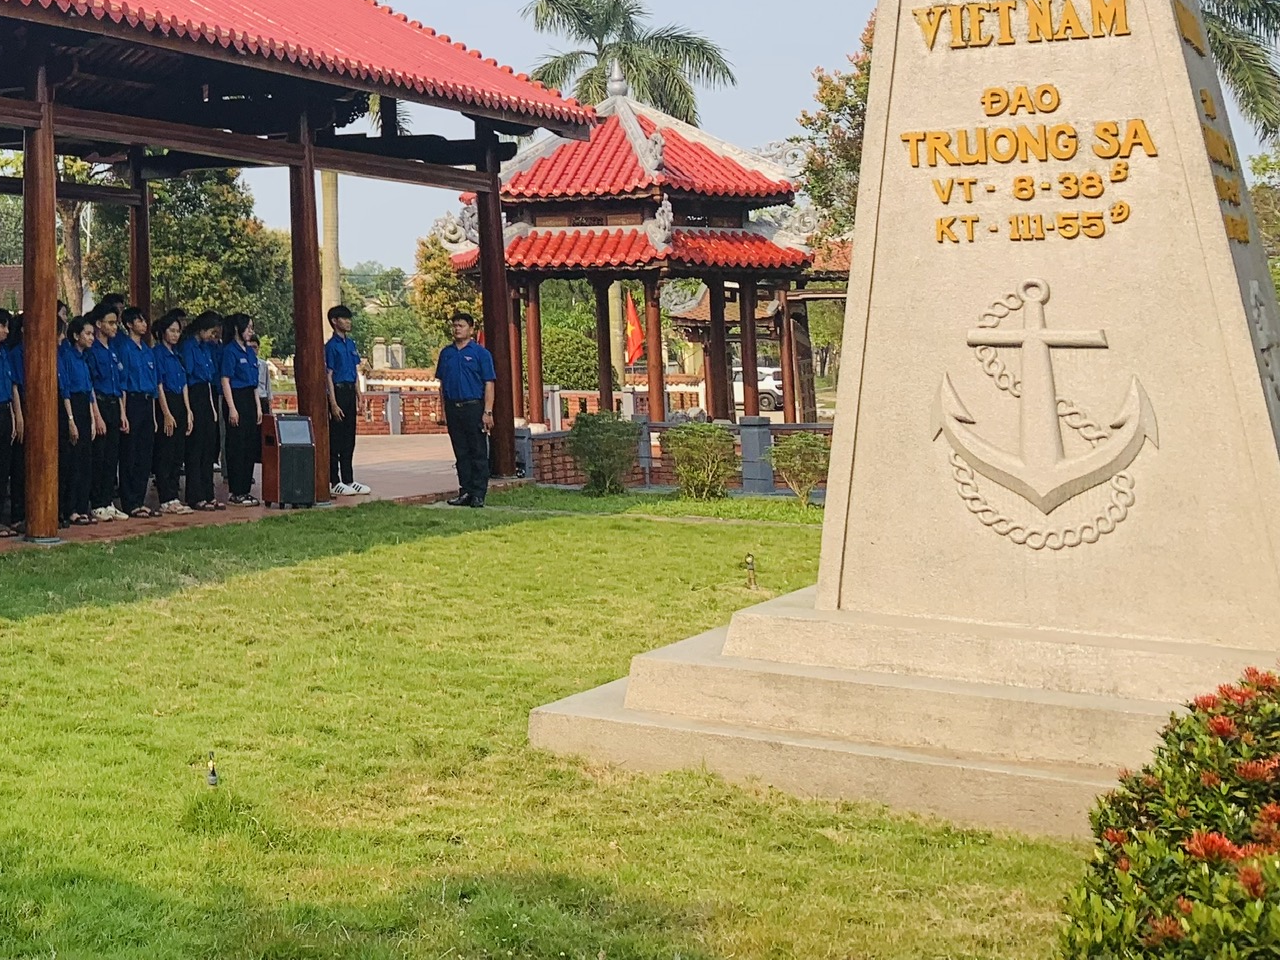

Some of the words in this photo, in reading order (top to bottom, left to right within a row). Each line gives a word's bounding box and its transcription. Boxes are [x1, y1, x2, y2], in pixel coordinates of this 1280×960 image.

[912, 0, 1018, 52] VIET
[980, 83, 1061, 117] ĐAO
[900, 123, 1079, 168] TRUONG
[1092, 119, 1158, 160] SA
